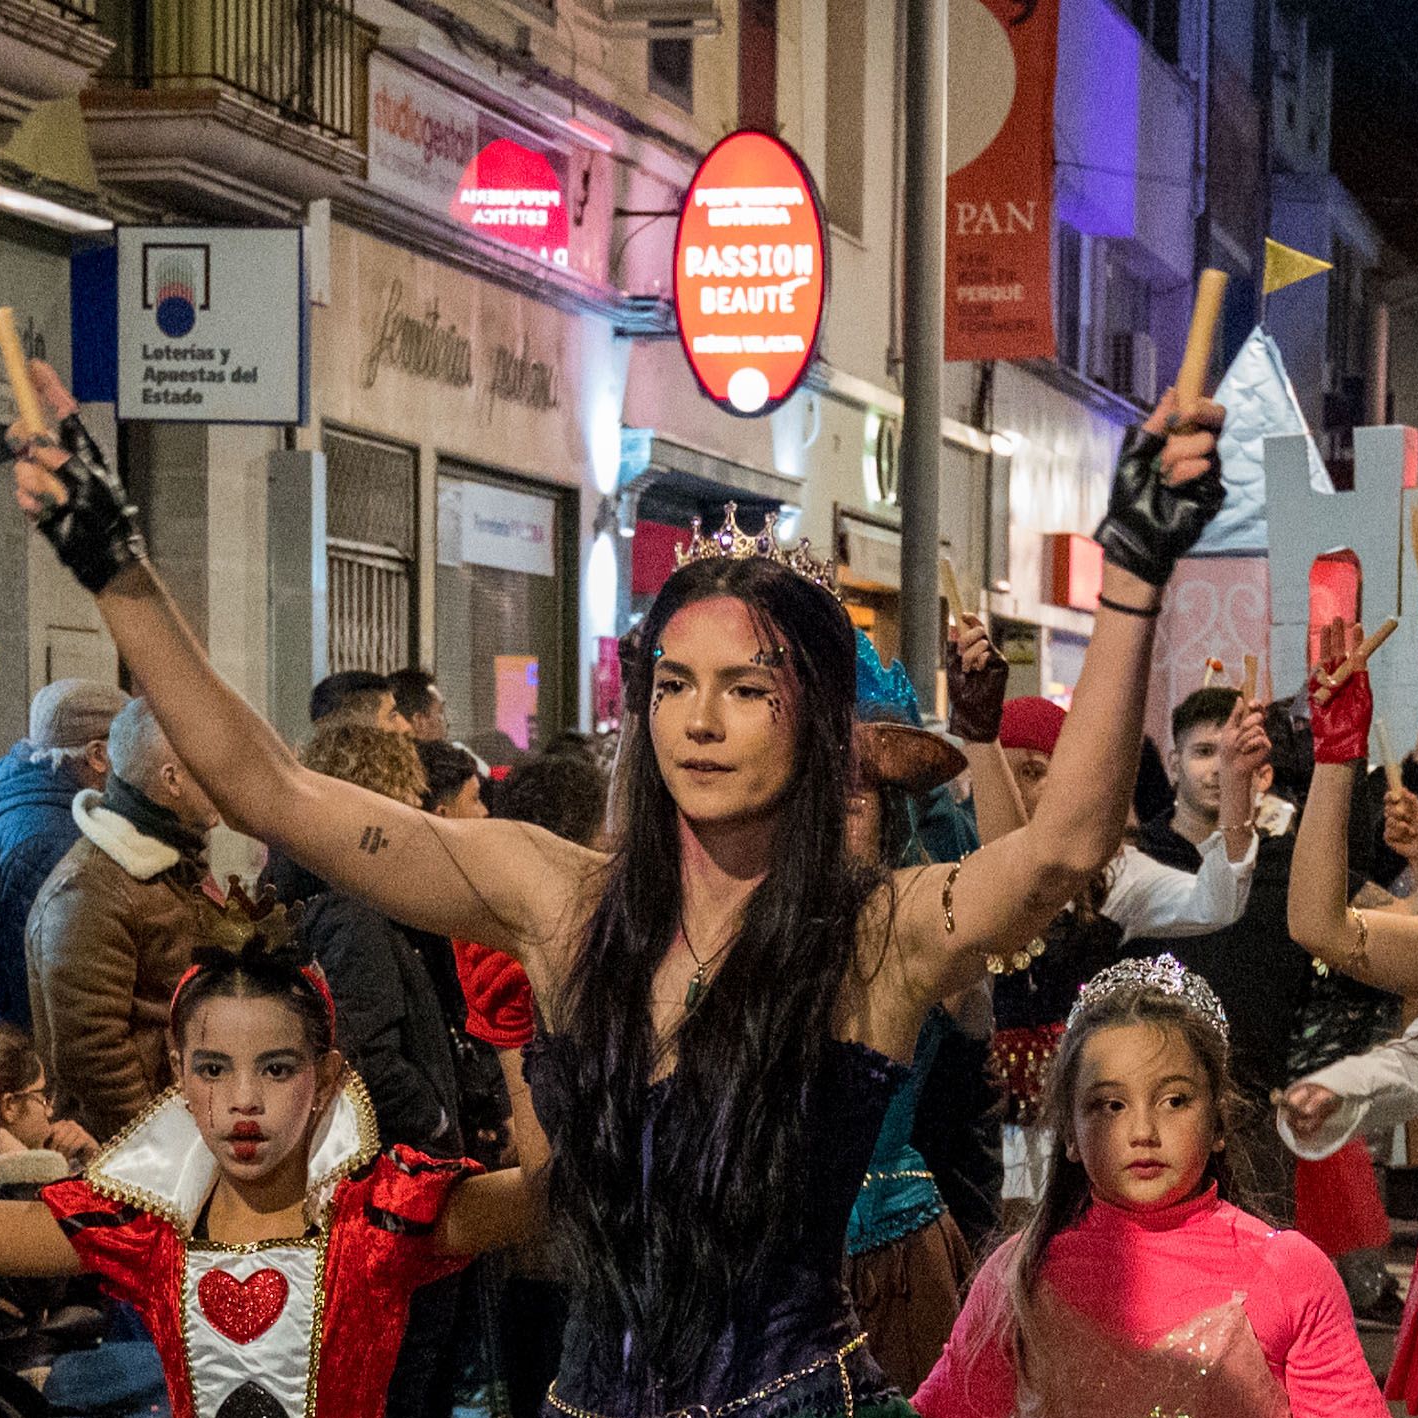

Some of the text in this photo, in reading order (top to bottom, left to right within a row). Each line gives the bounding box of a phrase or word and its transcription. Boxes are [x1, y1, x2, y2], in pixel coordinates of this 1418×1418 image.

[955, 201, 1037, 234] PAN
[685, 244, 813, 277] PASSION
[220, 349, 230, 365] y
[143, 366, 258, 386] Apuestas del
[142, 387, 203, 404] Estado
